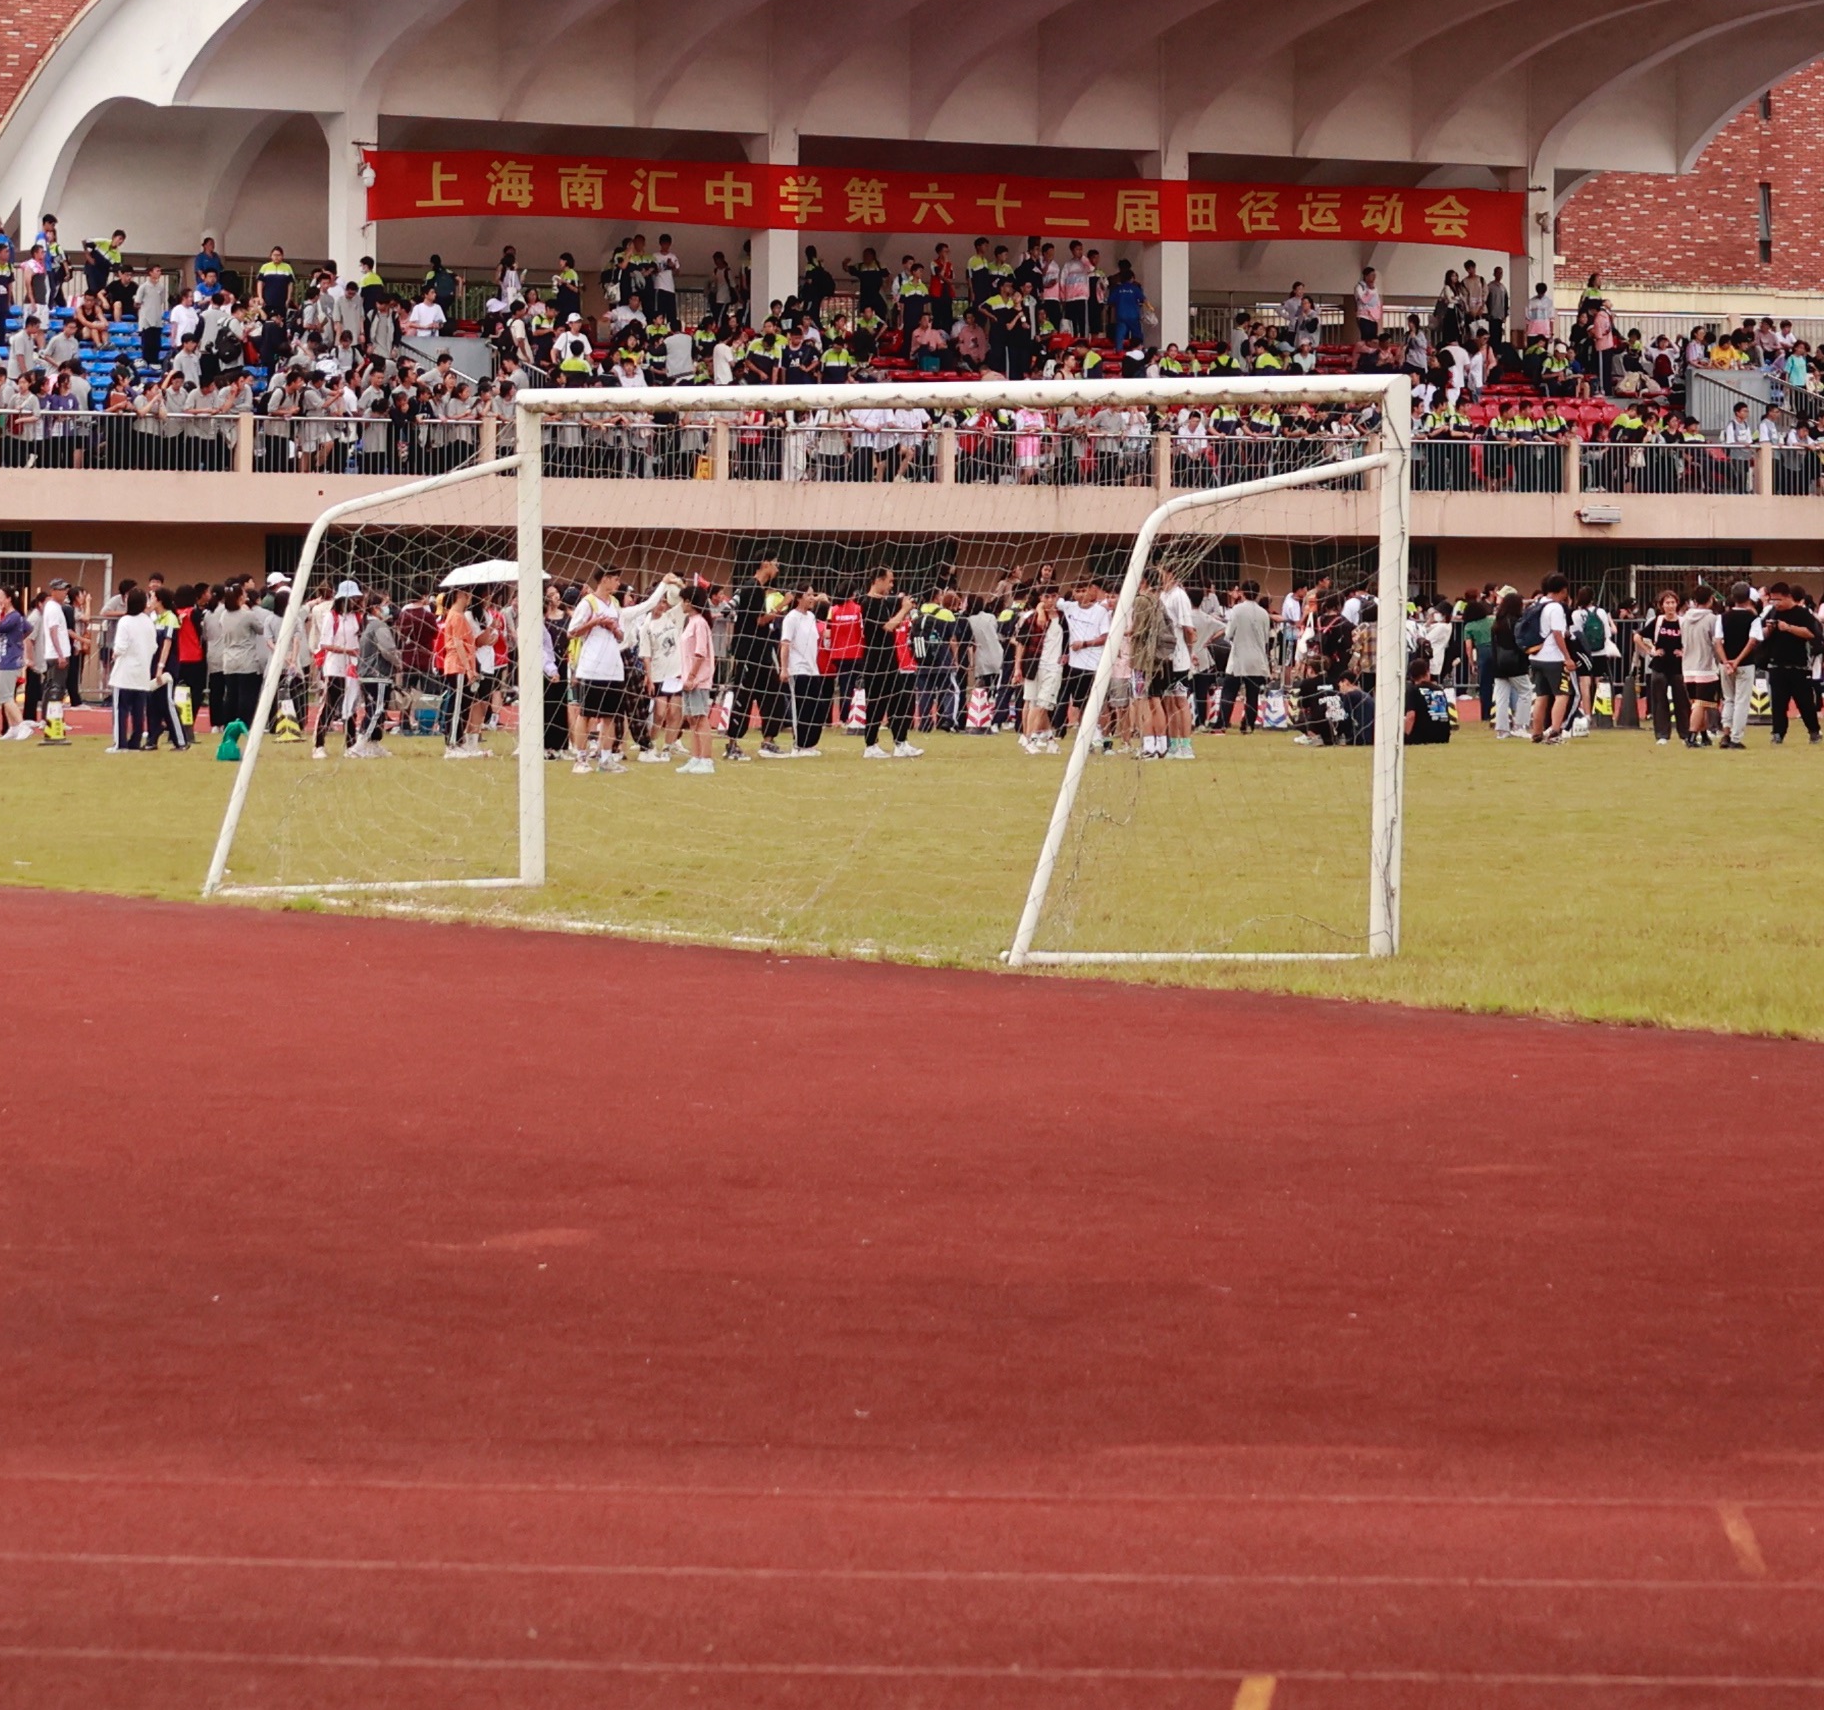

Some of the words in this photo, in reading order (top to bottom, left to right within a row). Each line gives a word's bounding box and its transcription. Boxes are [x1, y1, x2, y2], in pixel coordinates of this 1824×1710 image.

[415, 160, 1470, 239] 上海南汇中学第六十二届田径运动会
